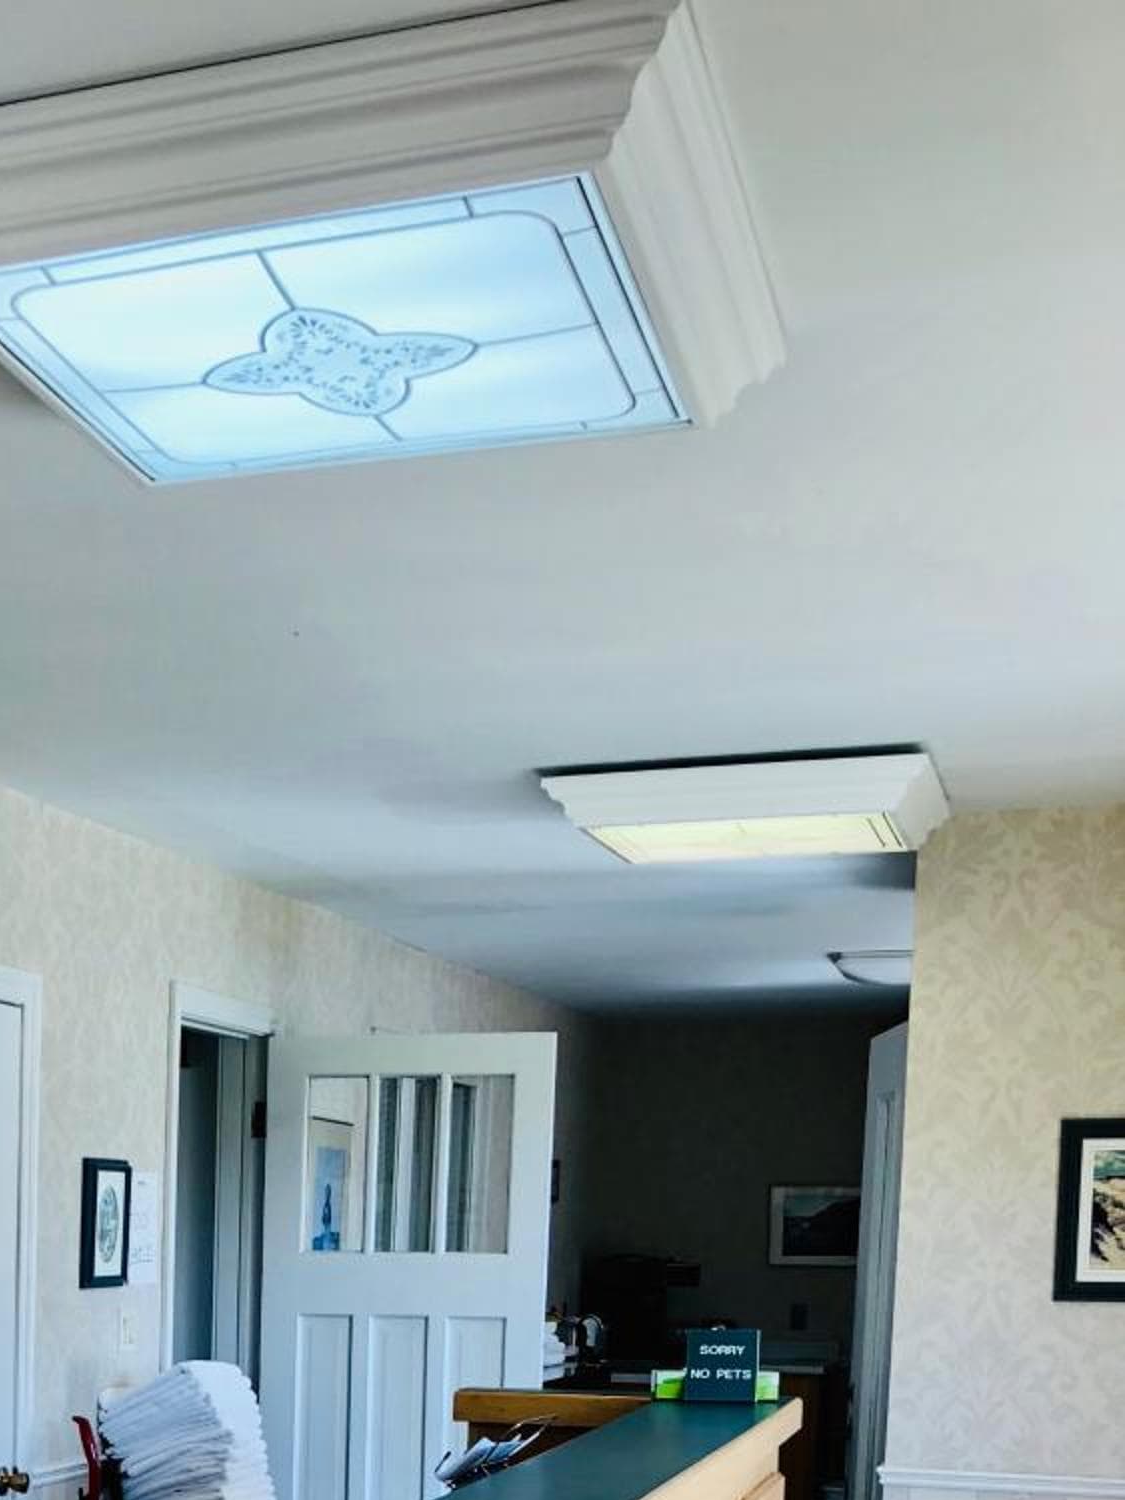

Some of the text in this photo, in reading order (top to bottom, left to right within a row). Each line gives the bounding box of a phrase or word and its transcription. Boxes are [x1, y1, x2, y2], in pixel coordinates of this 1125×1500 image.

[698, 1344, 746, 1356] SORRY
[690, 1368, 752, 1380] NO PETS
